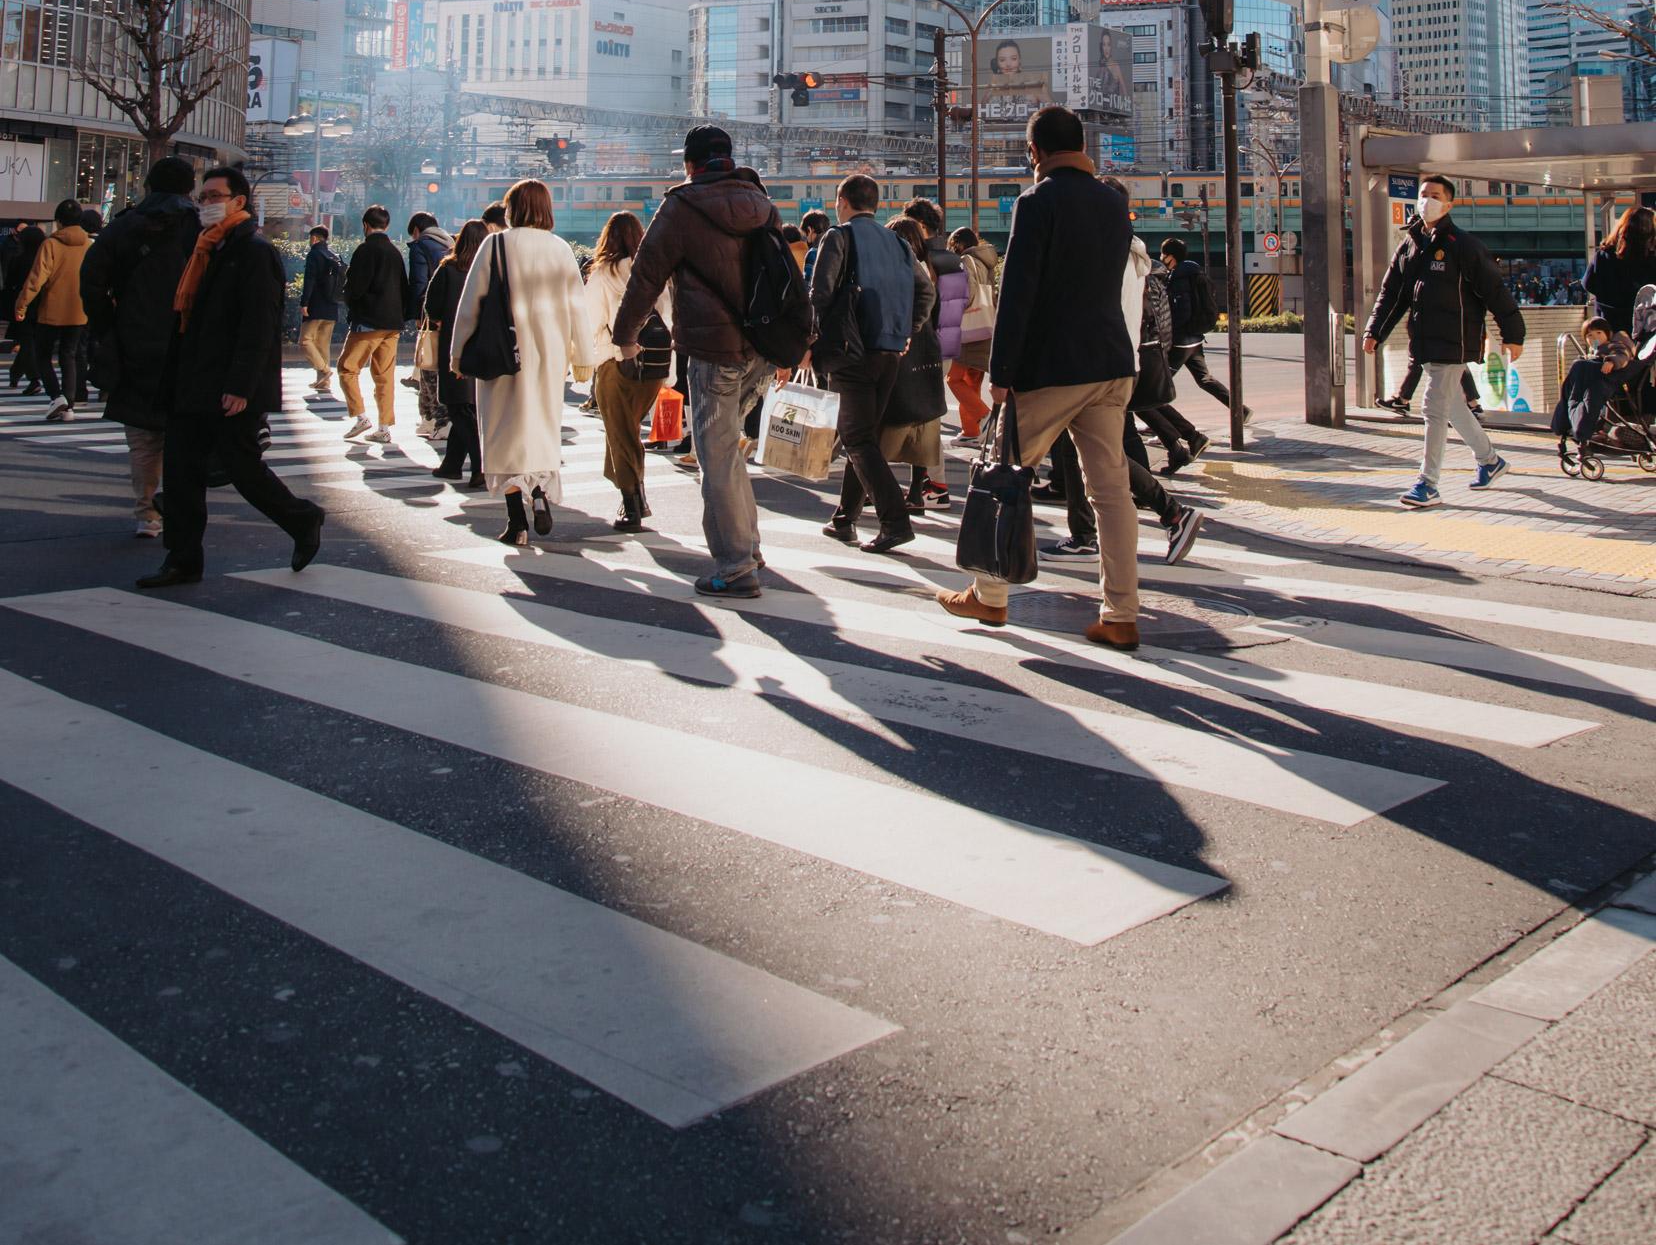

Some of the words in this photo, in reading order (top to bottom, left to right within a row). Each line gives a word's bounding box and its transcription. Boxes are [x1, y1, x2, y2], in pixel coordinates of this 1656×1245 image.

[493, 0, 524, 13] ODAKYU
[545, 0, 581, 8] CAMERA
[594, 20, 634, 37] ビックカメラ
[596, 39, 630, 58] ODAKYU
[1072, 34, 1082, 94] グローバル社
[1089, 89, 1132, 113] グローバル社
[1396, 207, 1401, 220] 3
[771, 423, 785, 434] KOO
[785, 428, 801, 438] SKIN
